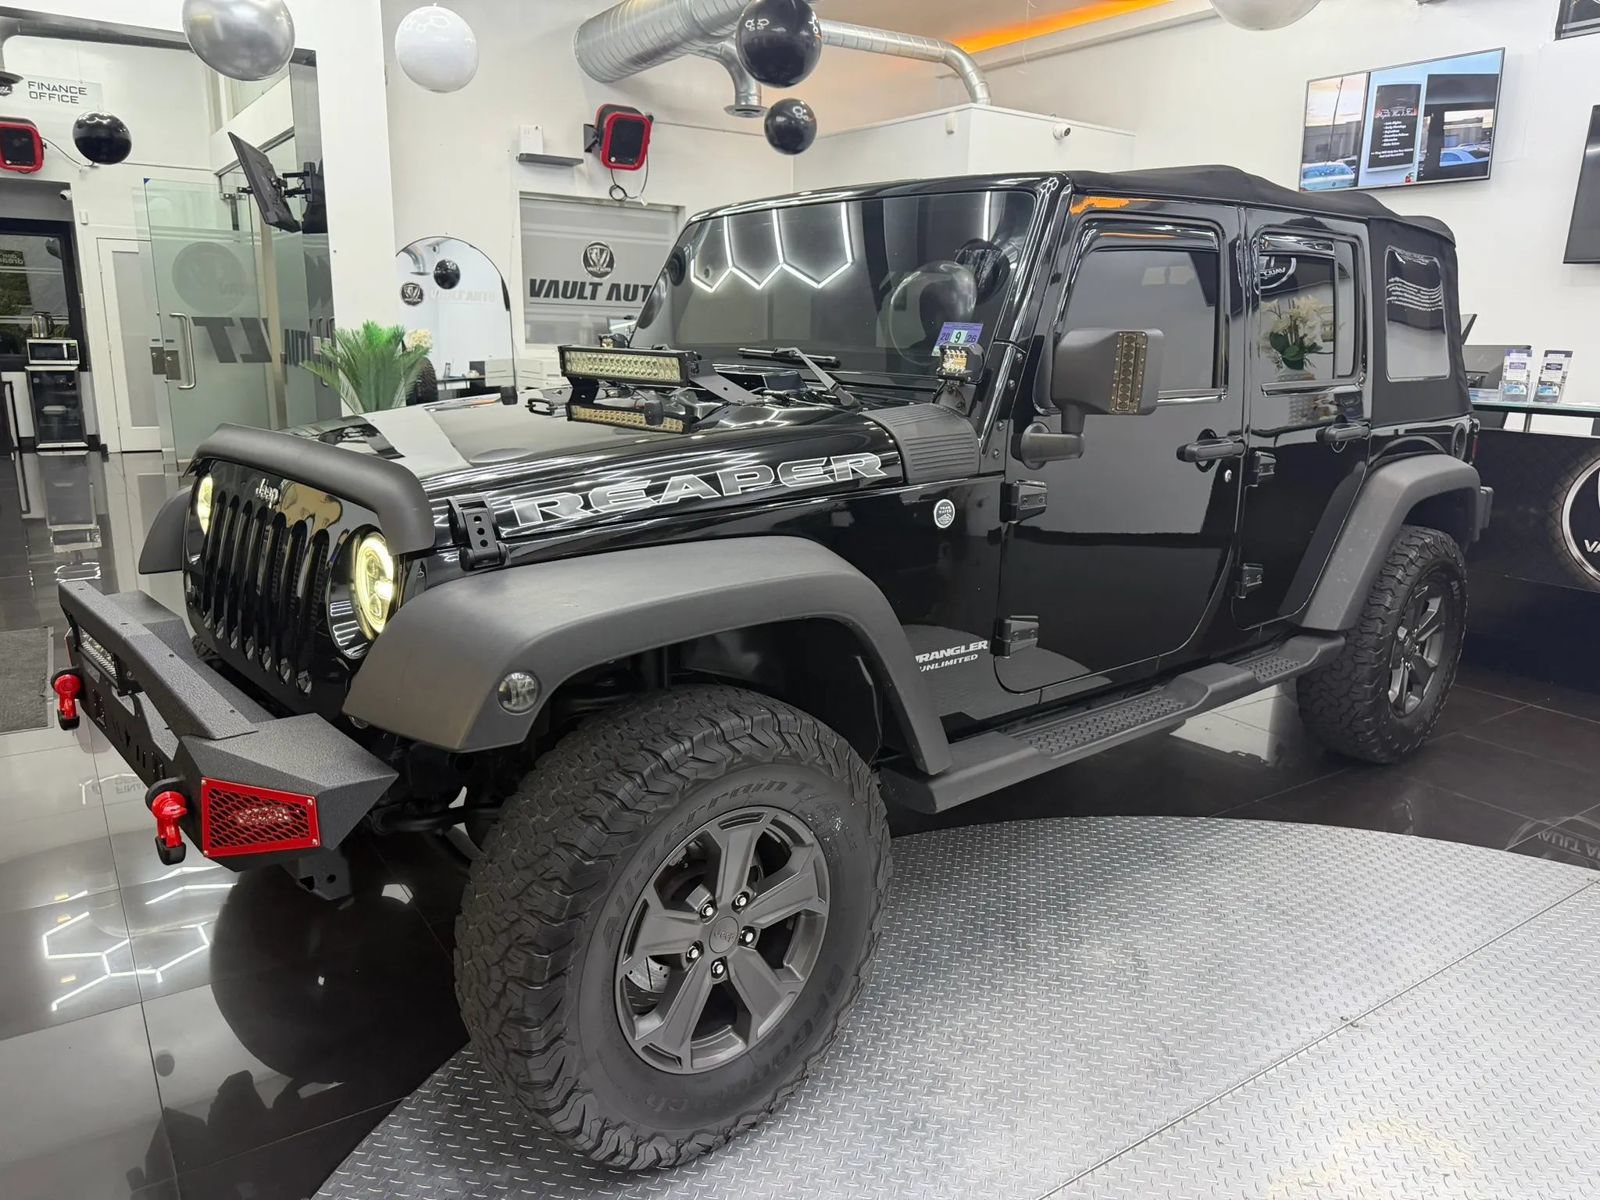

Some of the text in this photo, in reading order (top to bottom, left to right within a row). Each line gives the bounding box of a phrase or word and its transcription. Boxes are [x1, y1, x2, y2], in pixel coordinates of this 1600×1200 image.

[28, 81, 87, 95] FINANCE
[29, 91, 79, 104] OFFICE
[529, 278, 602, 300] VAULT
[954, 331, 962, 343] 9
[510, 452, 888, 526] REAPER
[919, 654, 979, 672] UNLIMITED
